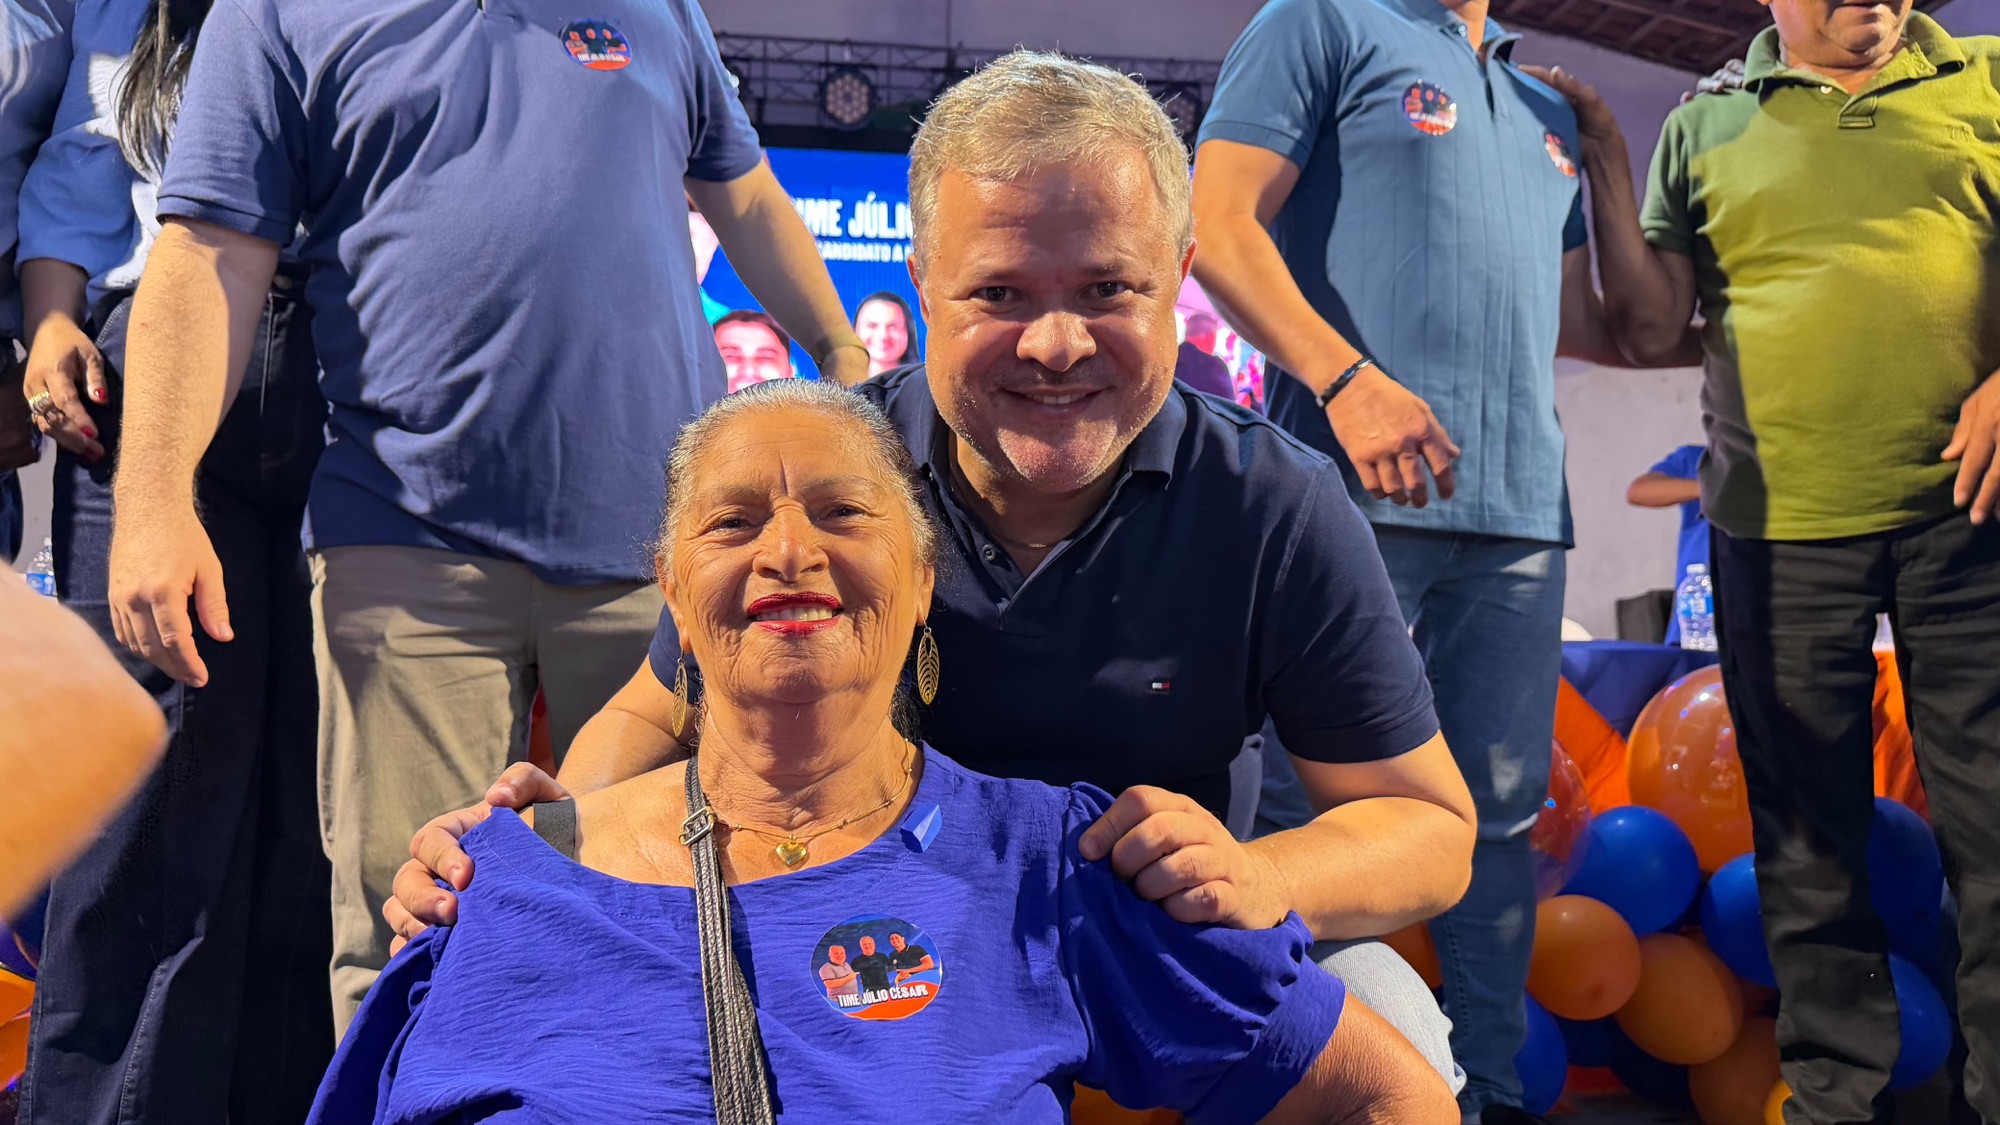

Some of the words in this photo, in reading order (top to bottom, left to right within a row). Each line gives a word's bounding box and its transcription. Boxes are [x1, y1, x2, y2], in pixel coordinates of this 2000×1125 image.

[838, 994, 861, 1008] TIME
[862, 989, 889, 1005] JÚLIO
[889, 985, 929, 1000] CÉSAR
